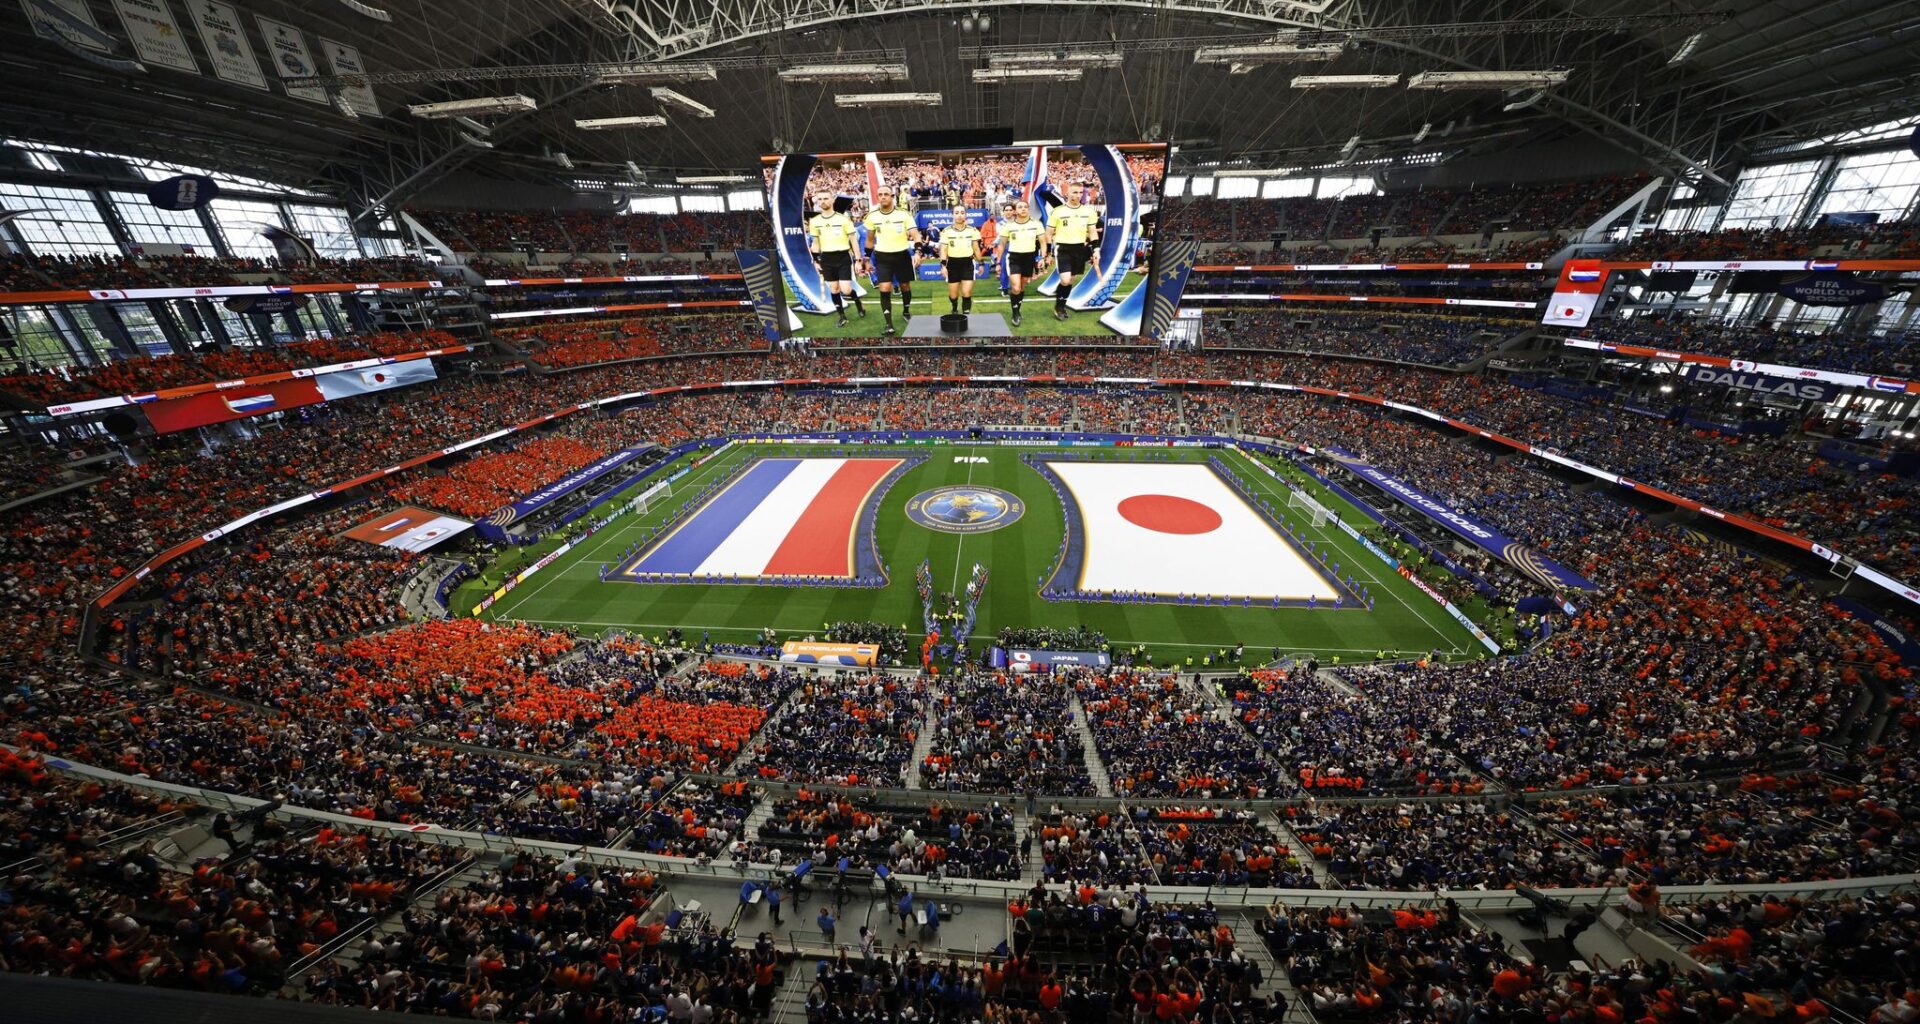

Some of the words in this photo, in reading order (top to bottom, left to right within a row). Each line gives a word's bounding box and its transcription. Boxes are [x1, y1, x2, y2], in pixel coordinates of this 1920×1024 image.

[1107, 218, 1122, 226] FIFA
[784, 227, 803, 235] FIFA
[1815, 280, 1840, 288] FIFA
[1795, 287, 1836, 296] WORLD
[1839, 289, 1866, 297] CUP
[1800, 370, 1817, 378] JAPAN
[1695, 370, 1825, 400] DALLAS
[51, 406, 72, 414] JAPAN
[954, 456, 989, 464] FIFA
[524, 492, 553, 505] FIFA
[551, 474, 587, 492] WORLD
[1363, 468, 1387, 481] FIFA
[1382, 479, 1423, 500] WORLD
[1417, 498, 1447, 513] CUP
[1439, 512, 1493, 539] 2026
[1363, 537, 1392, 566] Hisense
[536, 552, 560, 569] verizon
[1409, 574, 1447, 606] McDonald's
[797, 645, 853, 653] NETHERLANDS
[1093, 911, 1099, 922] 8
